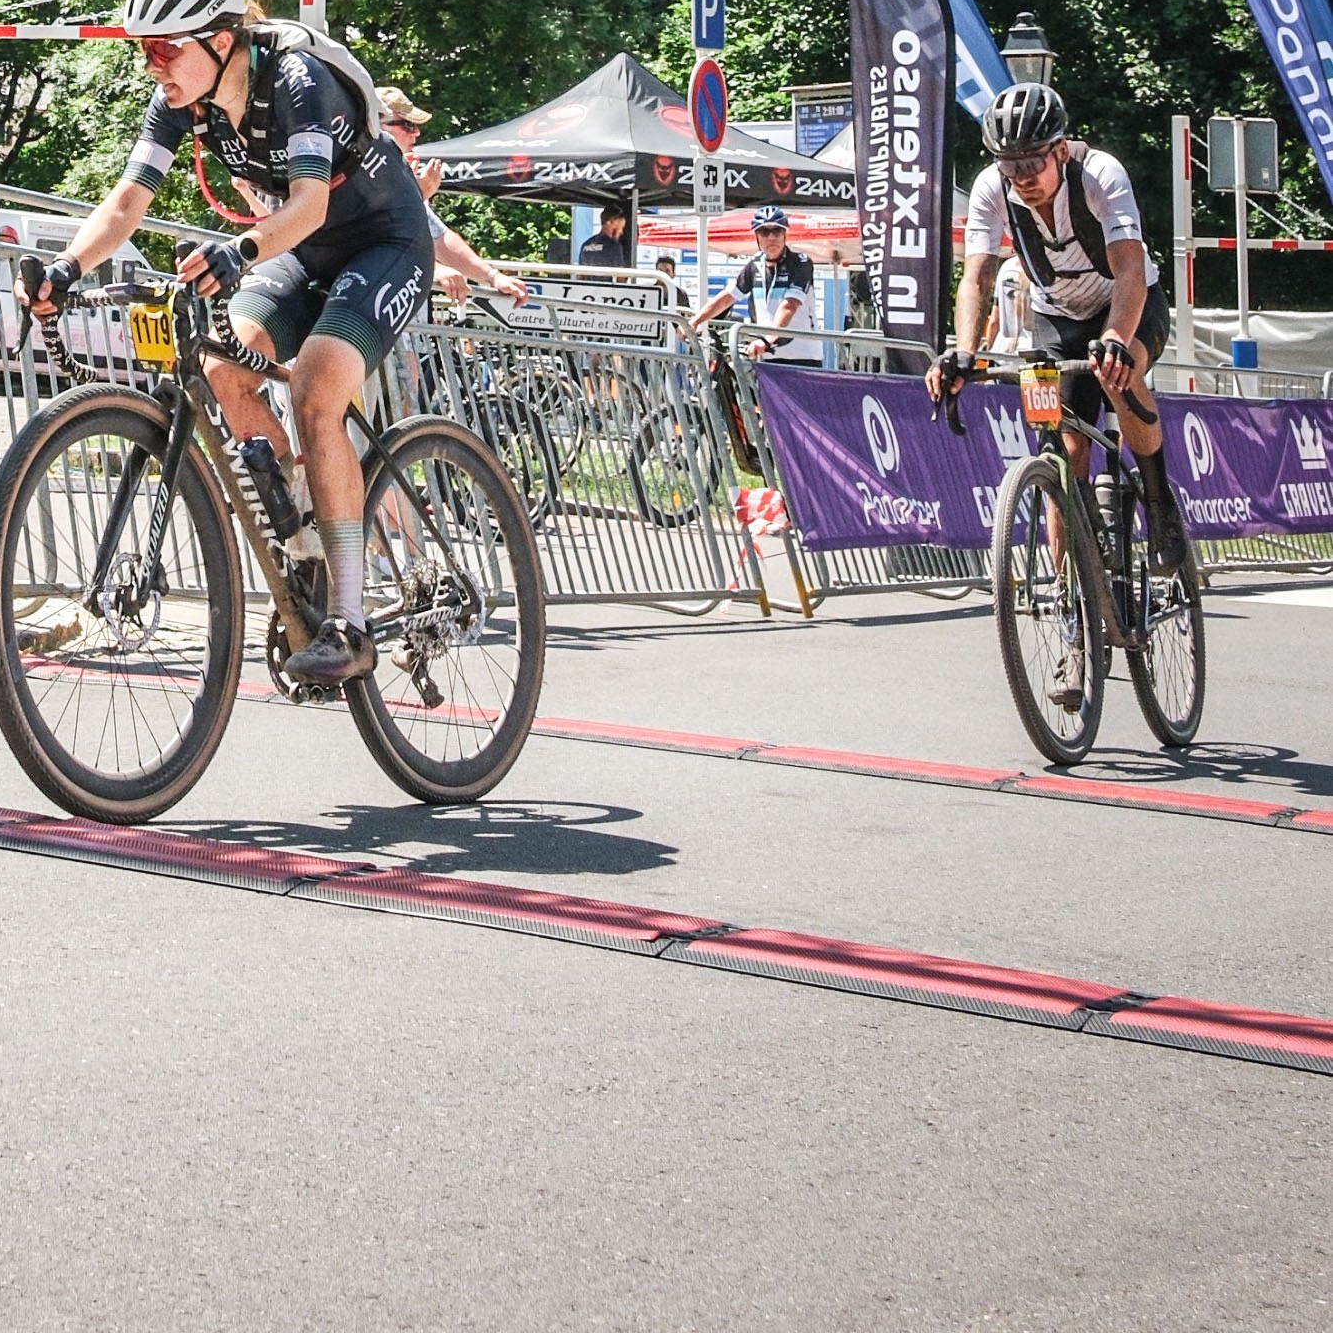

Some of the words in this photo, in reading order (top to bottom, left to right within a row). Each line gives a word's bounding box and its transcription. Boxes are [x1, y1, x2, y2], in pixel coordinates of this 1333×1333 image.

[533, 162, 616, 182] 24MX
[677, 165, 751, 190] 2MX
[795, 177, 857, 200] 24MX
[382, 265, 424, 328] ZZPR.nl
[132, 311, 171, 346] 1179
[507, 312, 545, 325] Centre
[598, 320, 609, 329] et
[613, 319, 656, 333] Sportif
[1023, 385, 1058, 411] 1666
[1178, 486, 1253, 524] Panaracer
[1280, 481, 1333, 518] GRAVEL
[141, 482, 170, 578] SPECIALIZED
[403, 605, 463, 632] SPECIALIZED
